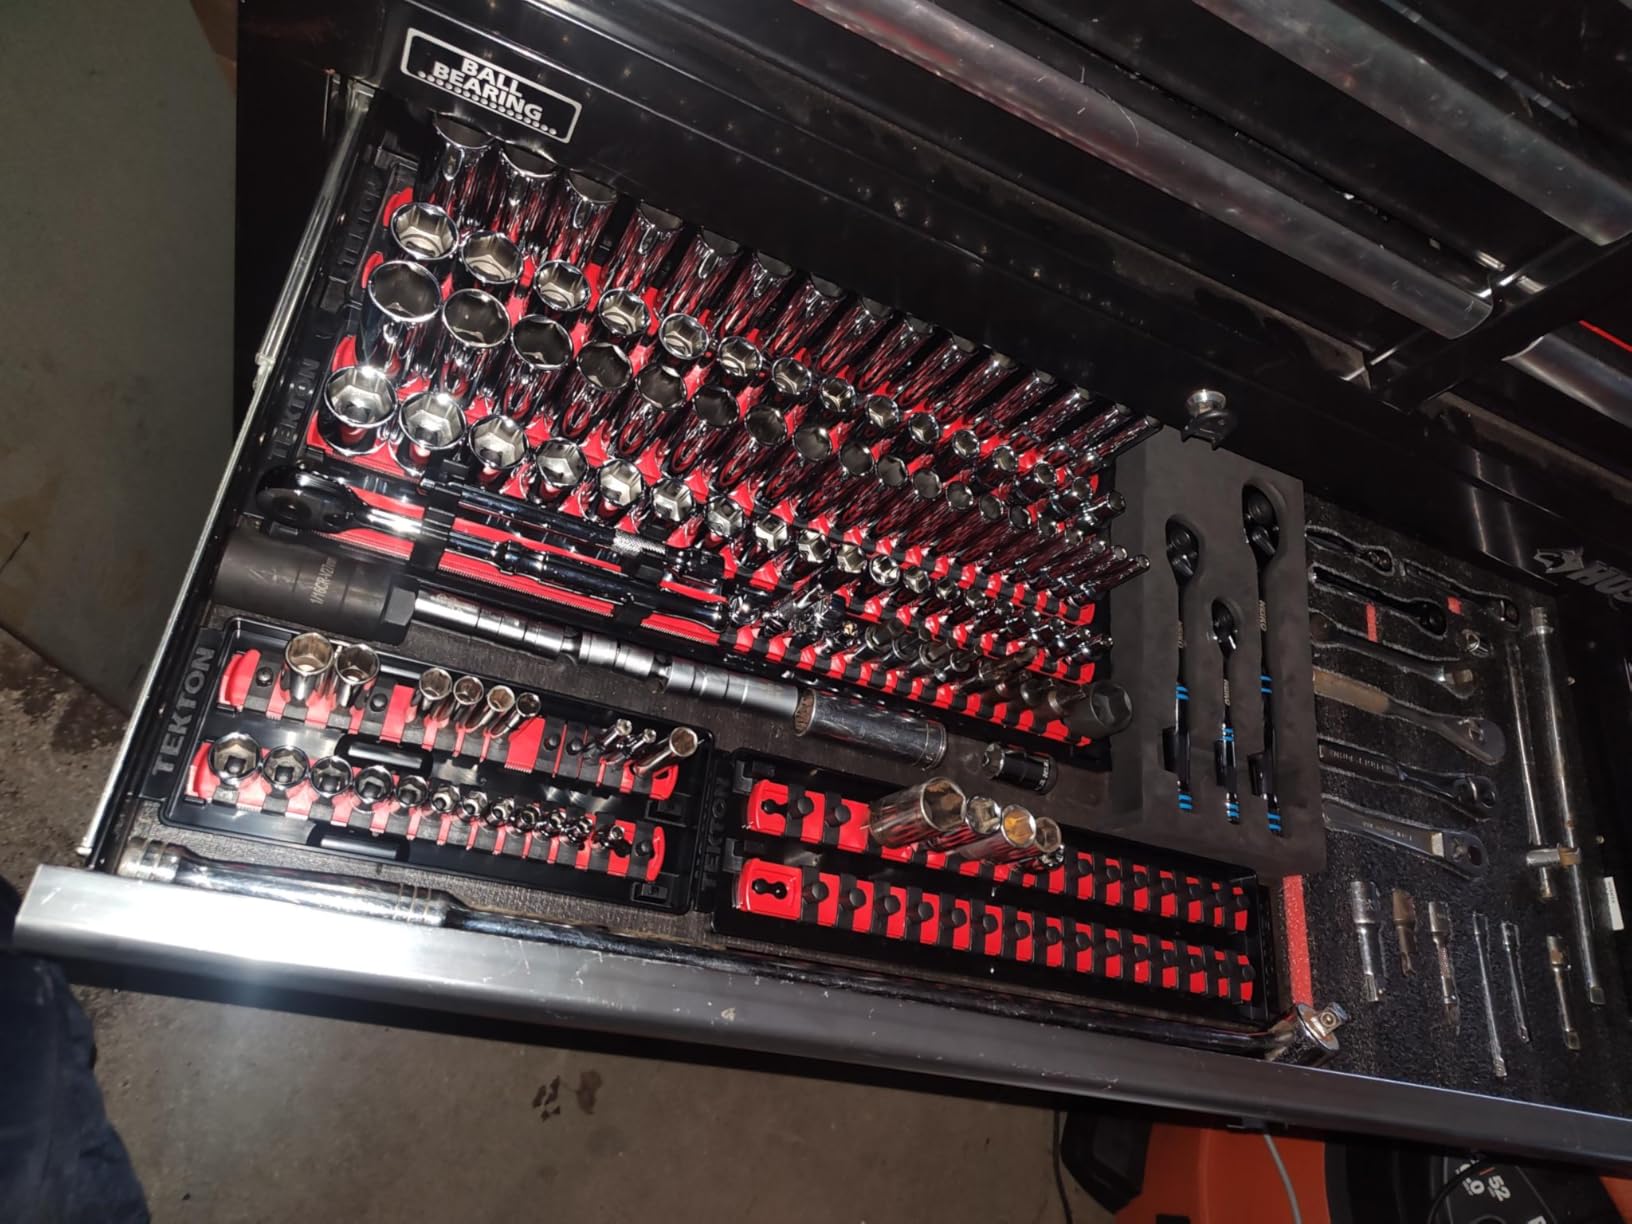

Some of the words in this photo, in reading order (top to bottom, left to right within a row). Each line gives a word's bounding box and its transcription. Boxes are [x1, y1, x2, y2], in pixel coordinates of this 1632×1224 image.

[433, 61, 543, 122] BEARING
[461, 57, 523, 98] BALL
[152, 647, 216, 775] TEKTON
[1488, 1175, 1511, 1202] 52
